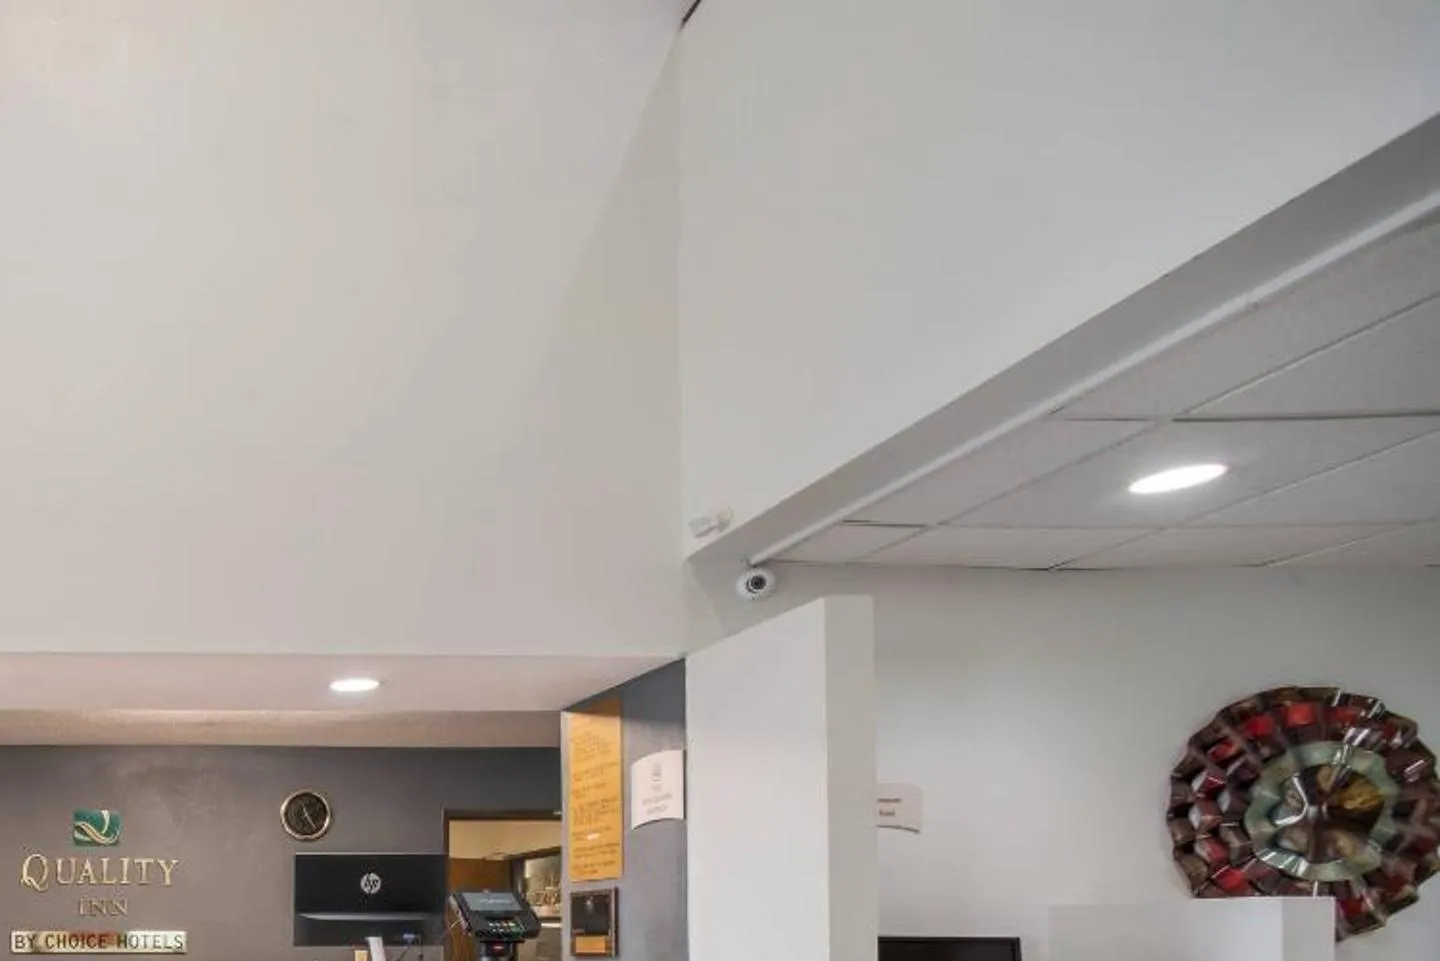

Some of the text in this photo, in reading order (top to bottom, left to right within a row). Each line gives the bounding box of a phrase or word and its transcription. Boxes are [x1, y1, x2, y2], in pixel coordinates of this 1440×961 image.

[21, 854, 178, 891] QUALITY
[79, 899, 128, 916] INN
[15, 933, 184, 950] BY CHOICE HOTELS
